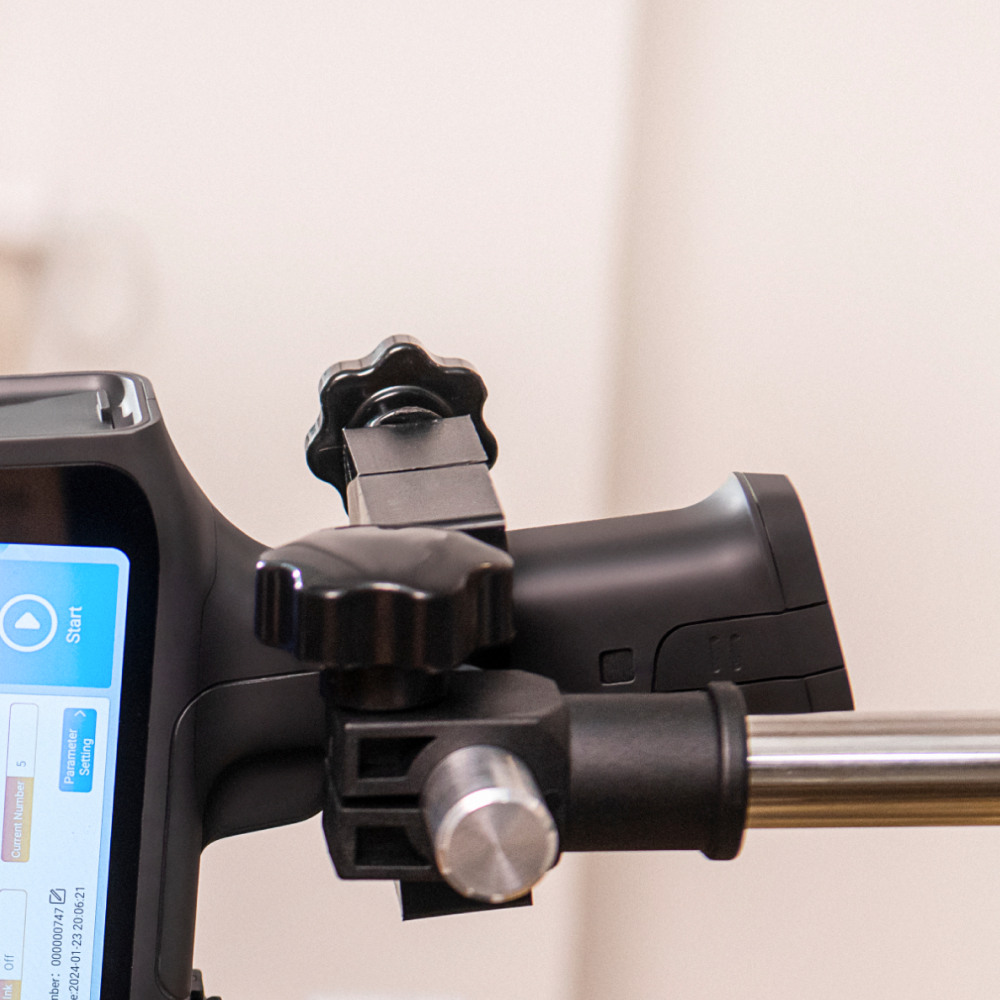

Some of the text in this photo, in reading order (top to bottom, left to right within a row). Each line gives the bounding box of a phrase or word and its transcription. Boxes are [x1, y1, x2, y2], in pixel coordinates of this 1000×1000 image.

[66, 606, 82, 644] Start
[64, 728, 78, 785] Parameter
[79, 738, 94, 776] Setting
[11, 781, 25, 858] Current Number
[72, 887, 85, 931] 20:06:21
[51, 907, 64, 967] 000000747
[3, 954, 14, 971] Off
[2, 983, 13, 1000] Ink
